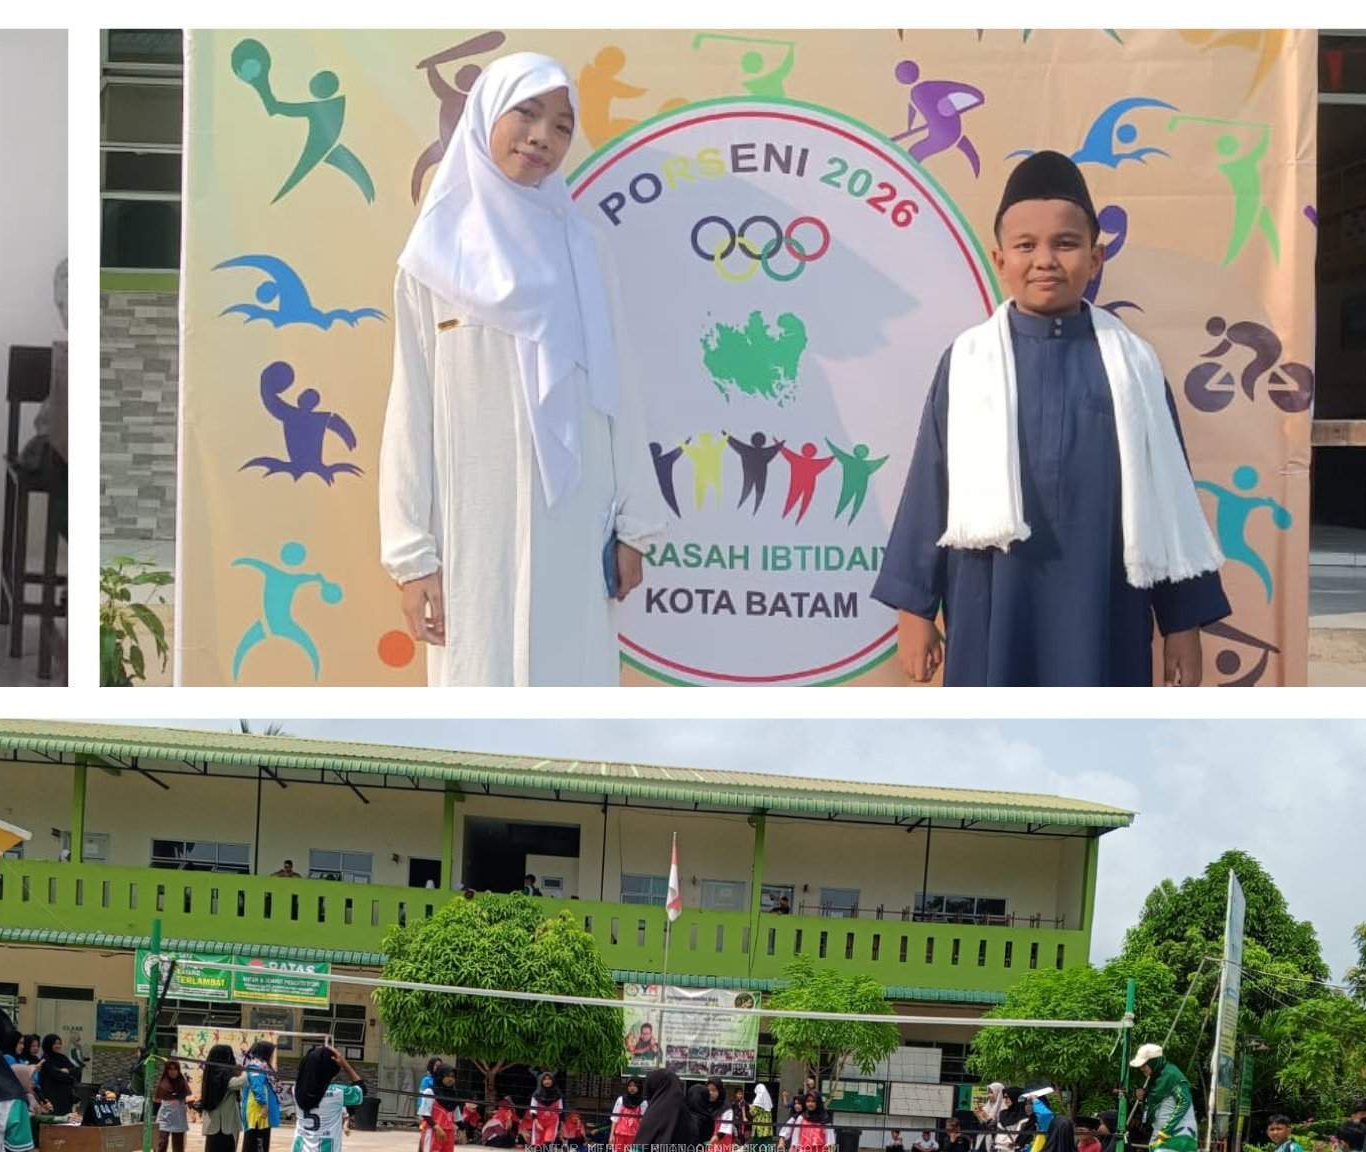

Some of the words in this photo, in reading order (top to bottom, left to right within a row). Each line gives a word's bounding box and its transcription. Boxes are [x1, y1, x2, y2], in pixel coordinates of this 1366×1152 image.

[598, 142, 810, 226] PORSENI
[819, 156, 921, 229] 2026
[641, 543, 749, 572] RASAH
[644, 588, 736, 615] KOTA
[745, 590, 860, 619] BATAM
[176, 975, 226, 987] TERLAMBAT
